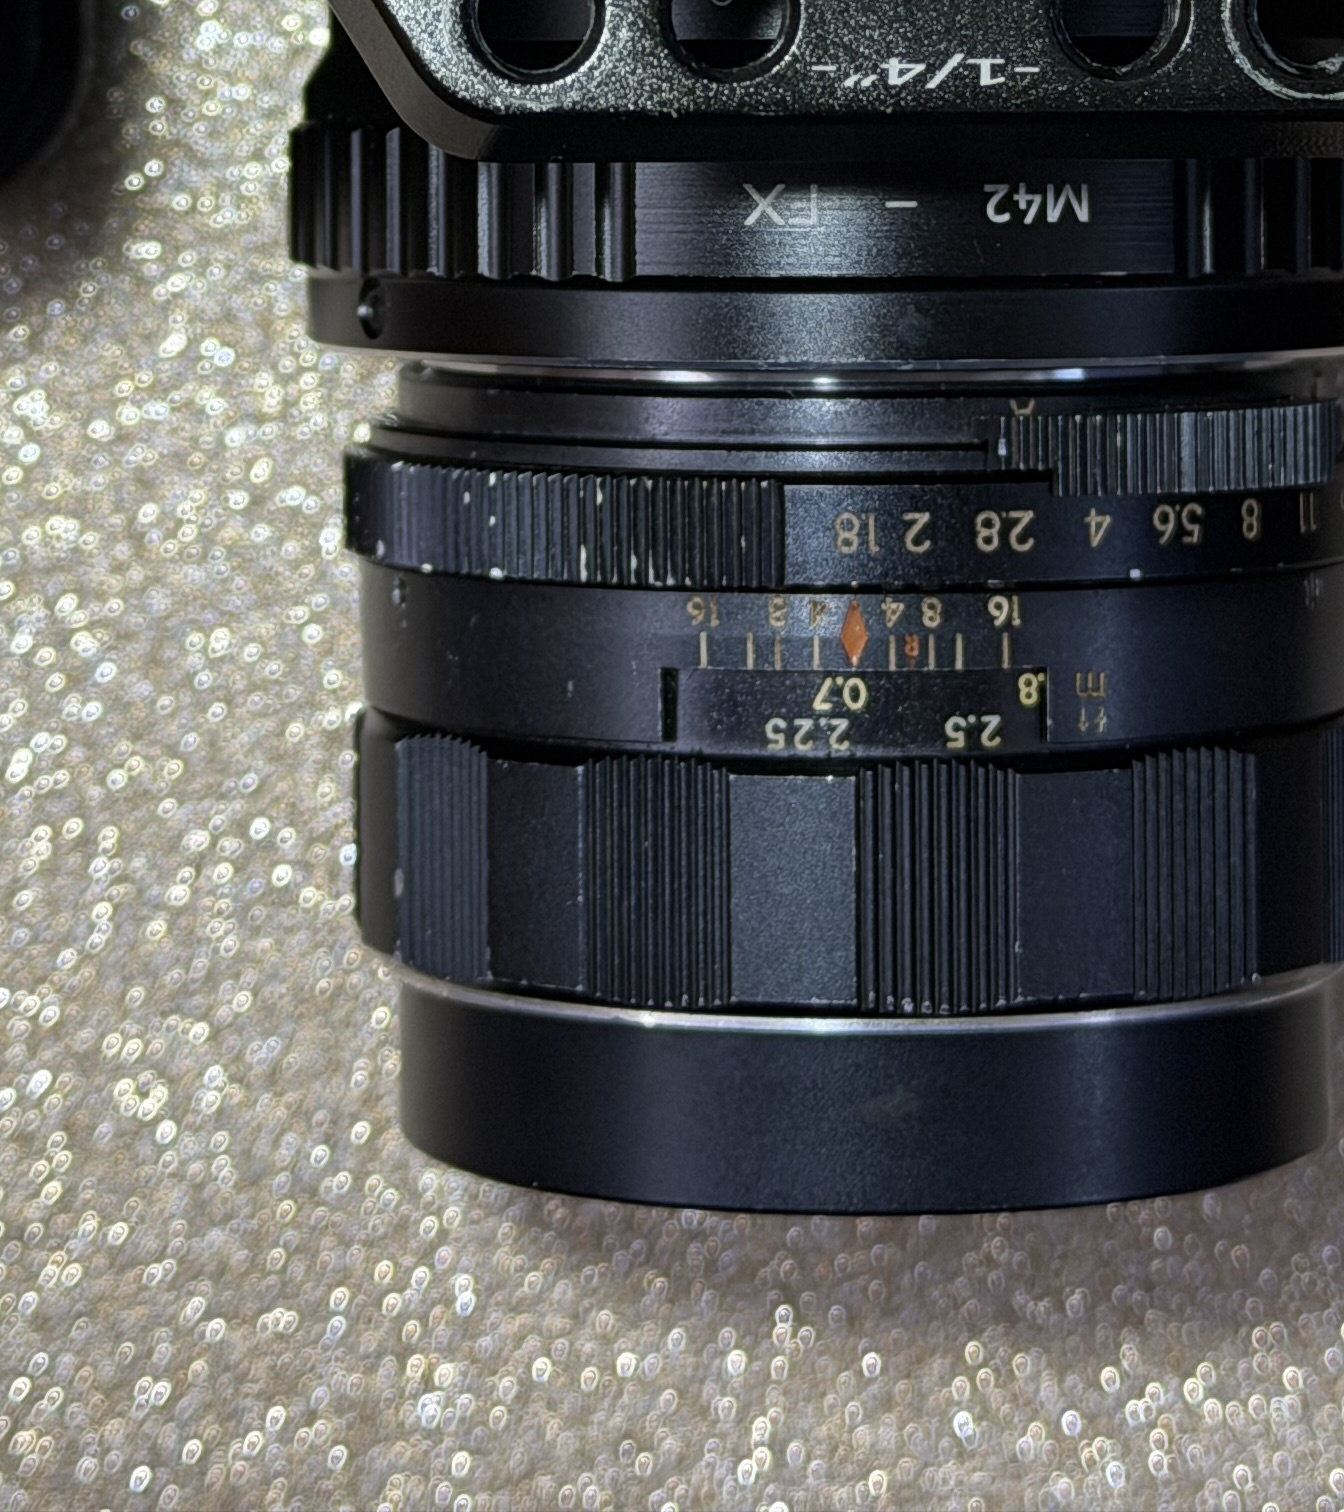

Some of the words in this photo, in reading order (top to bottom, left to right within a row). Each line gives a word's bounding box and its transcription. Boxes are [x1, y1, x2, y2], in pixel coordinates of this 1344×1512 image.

[742, 182, 820, 226] FX
[983, 182, 1089, 224] M42
[833, 511, 881, 554] 1.8
[902, 511, 932, 554] 2
[973, 510, 1036, 554] 2.8
[1084, 507, 1112, 548] 4
[1152, 502, 1204, 546] 5.6
[1240, 498, 1258, 540] 8
[1299, 492, 1317, 535] 11
[686, 595, 721, 628] 16
[880, 596, 905, 628] 4
[921, 596, 943, 628] 8
[986, 595, 1023, 628] 16
[904, 634, 919, 658] R
[811, 676, 869, 711] 0.7
[1076, 671, 1107, 699] m
[763, 716, 850, 751] 2.25
[943, 713, 1002, 748] 2.5
